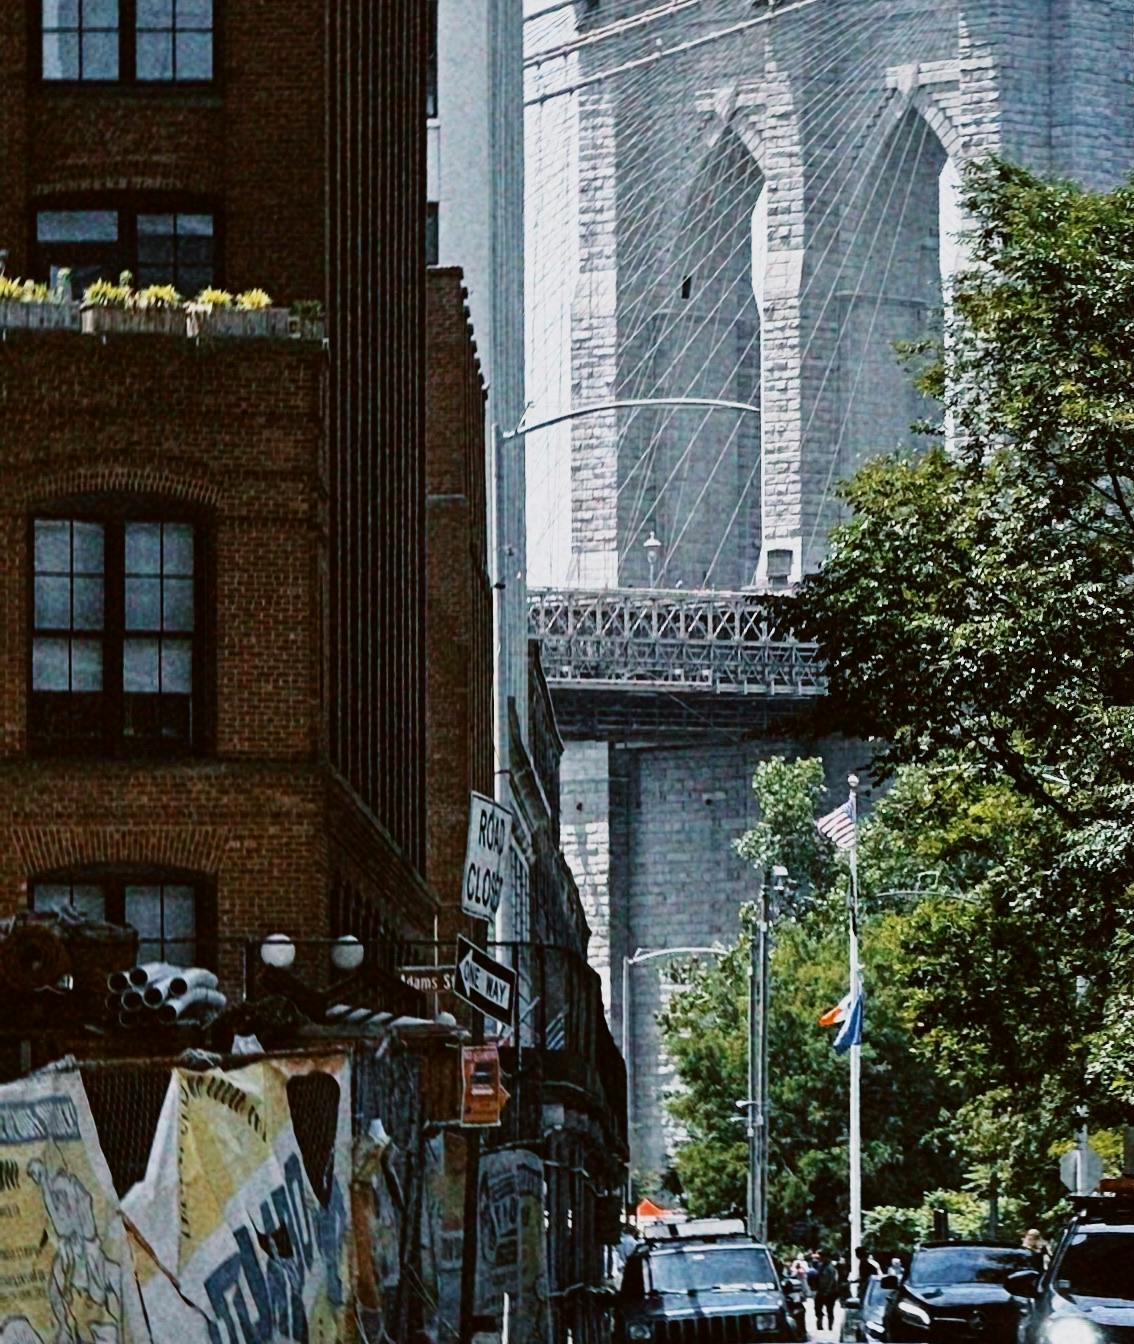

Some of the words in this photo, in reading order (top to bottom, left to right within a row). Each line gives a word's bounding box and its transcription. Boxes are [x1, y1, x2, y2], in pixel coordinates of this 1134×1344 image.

[478, 808, 506, 856] ROAD
[466, 862, 504, 913] CLOS
[463, 959, 481, 990] ONE
[485, 976, 507, 1003] WAY
